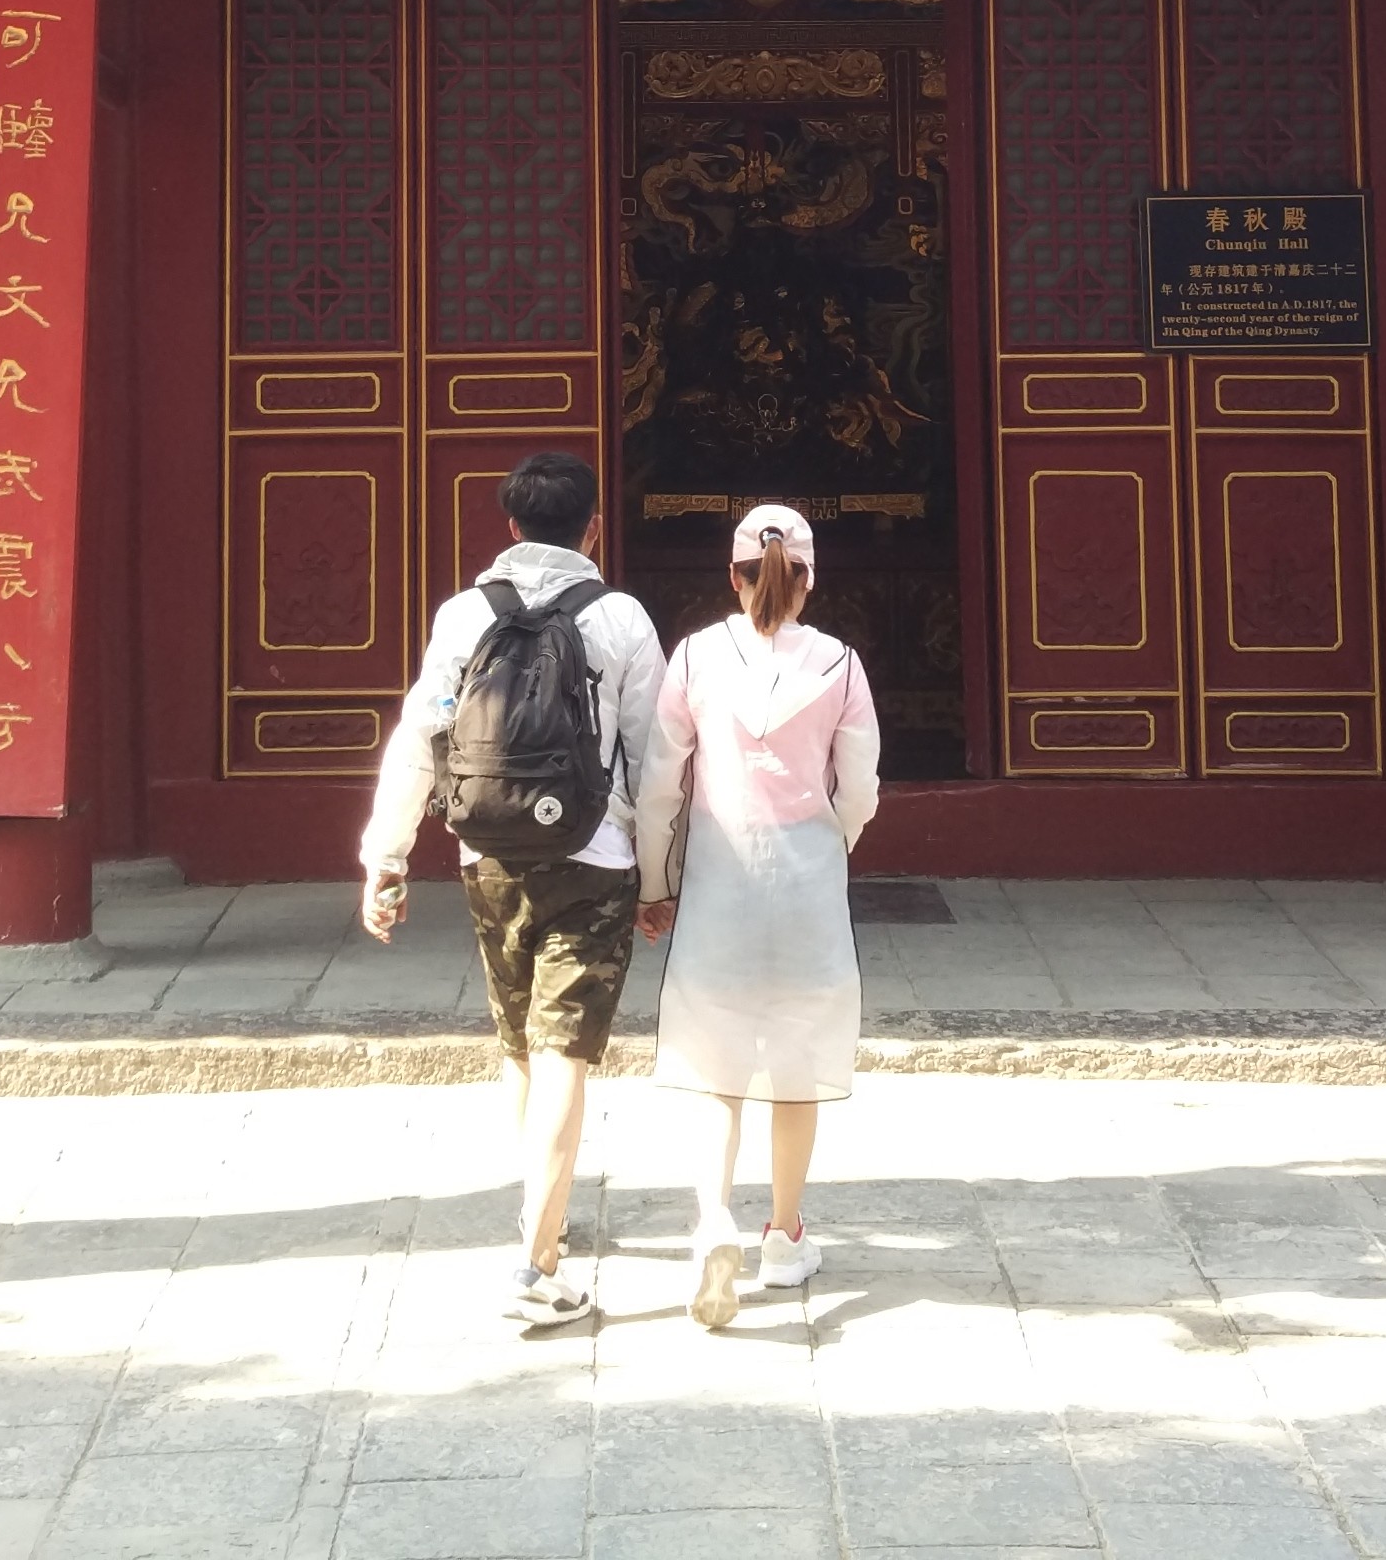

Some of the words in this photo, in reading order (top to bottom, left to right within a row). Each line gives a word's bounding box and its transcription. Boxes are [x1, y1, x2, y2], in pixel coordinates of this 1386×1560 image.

[1205, 207, 1307, 232] 春秋殿
[1205, 239, 1267, 252] Chunqiu
[1278, 238, 1309, 250] Hall
[1189, 263, 1357, 278] 现存建筑建于清嘉庆二十二
[1181, 301, 1191, 310] It
[1197, 300, 1265, 310] constructed
[1268, 300, 1279, 309] in
[1340, 300, 1357, 309] the
[1162, 314, 1246, 325] twenty-second
[1249, 315, 1274, 325] year
[1277, 314, 1289, 323] of
[1292, 313, 1311, 322] the
[1313, 313, 1343, 325] reign
[1346, 312, 1359, 322] of
[1162, 327, 1180, 337] Jia
[1182, 327, 1208, 338] Qing
[1210, 326, 1223, 336] of
[1225, 326, 1243, 336] the
[1245, 326, 1272, 338] Qing
